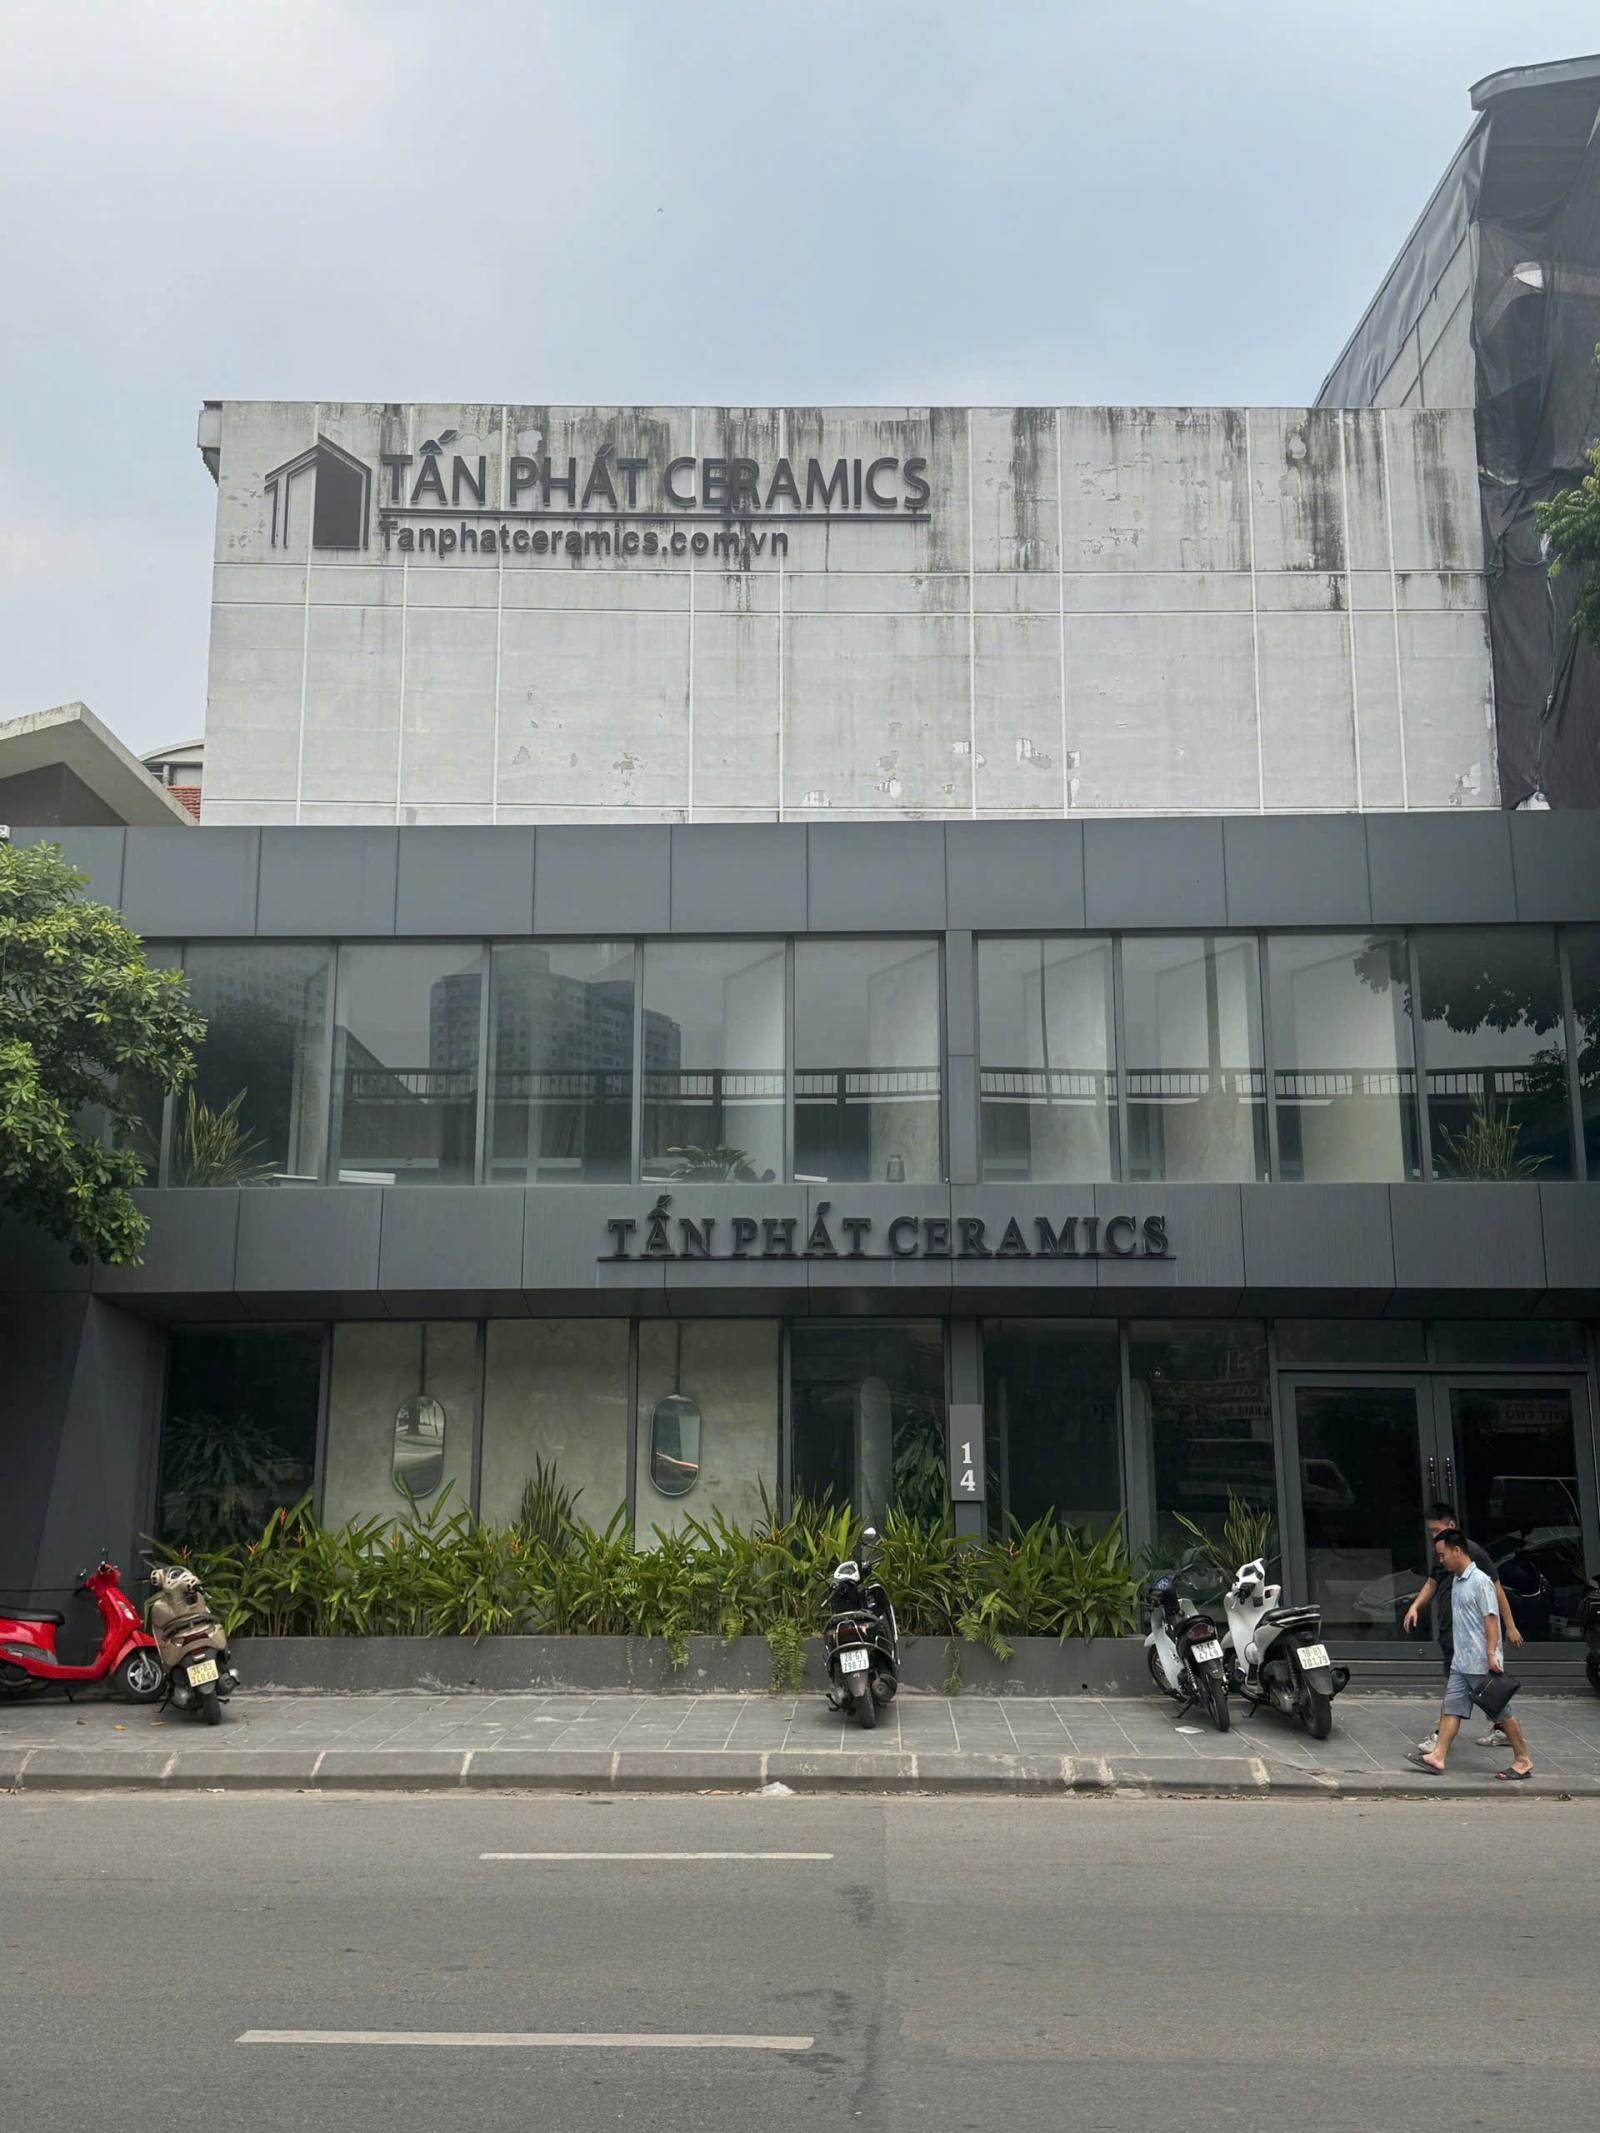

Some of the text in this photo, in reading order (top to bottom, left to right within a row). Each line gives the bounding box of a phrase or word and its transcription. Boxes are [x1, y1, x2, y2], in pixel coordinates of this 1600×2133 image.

[380, 429, 931, 510] TẤN PHÁT CERAMICS
[608, 1194, 1170, 1258] TẤN PHÁT CERAMICS
